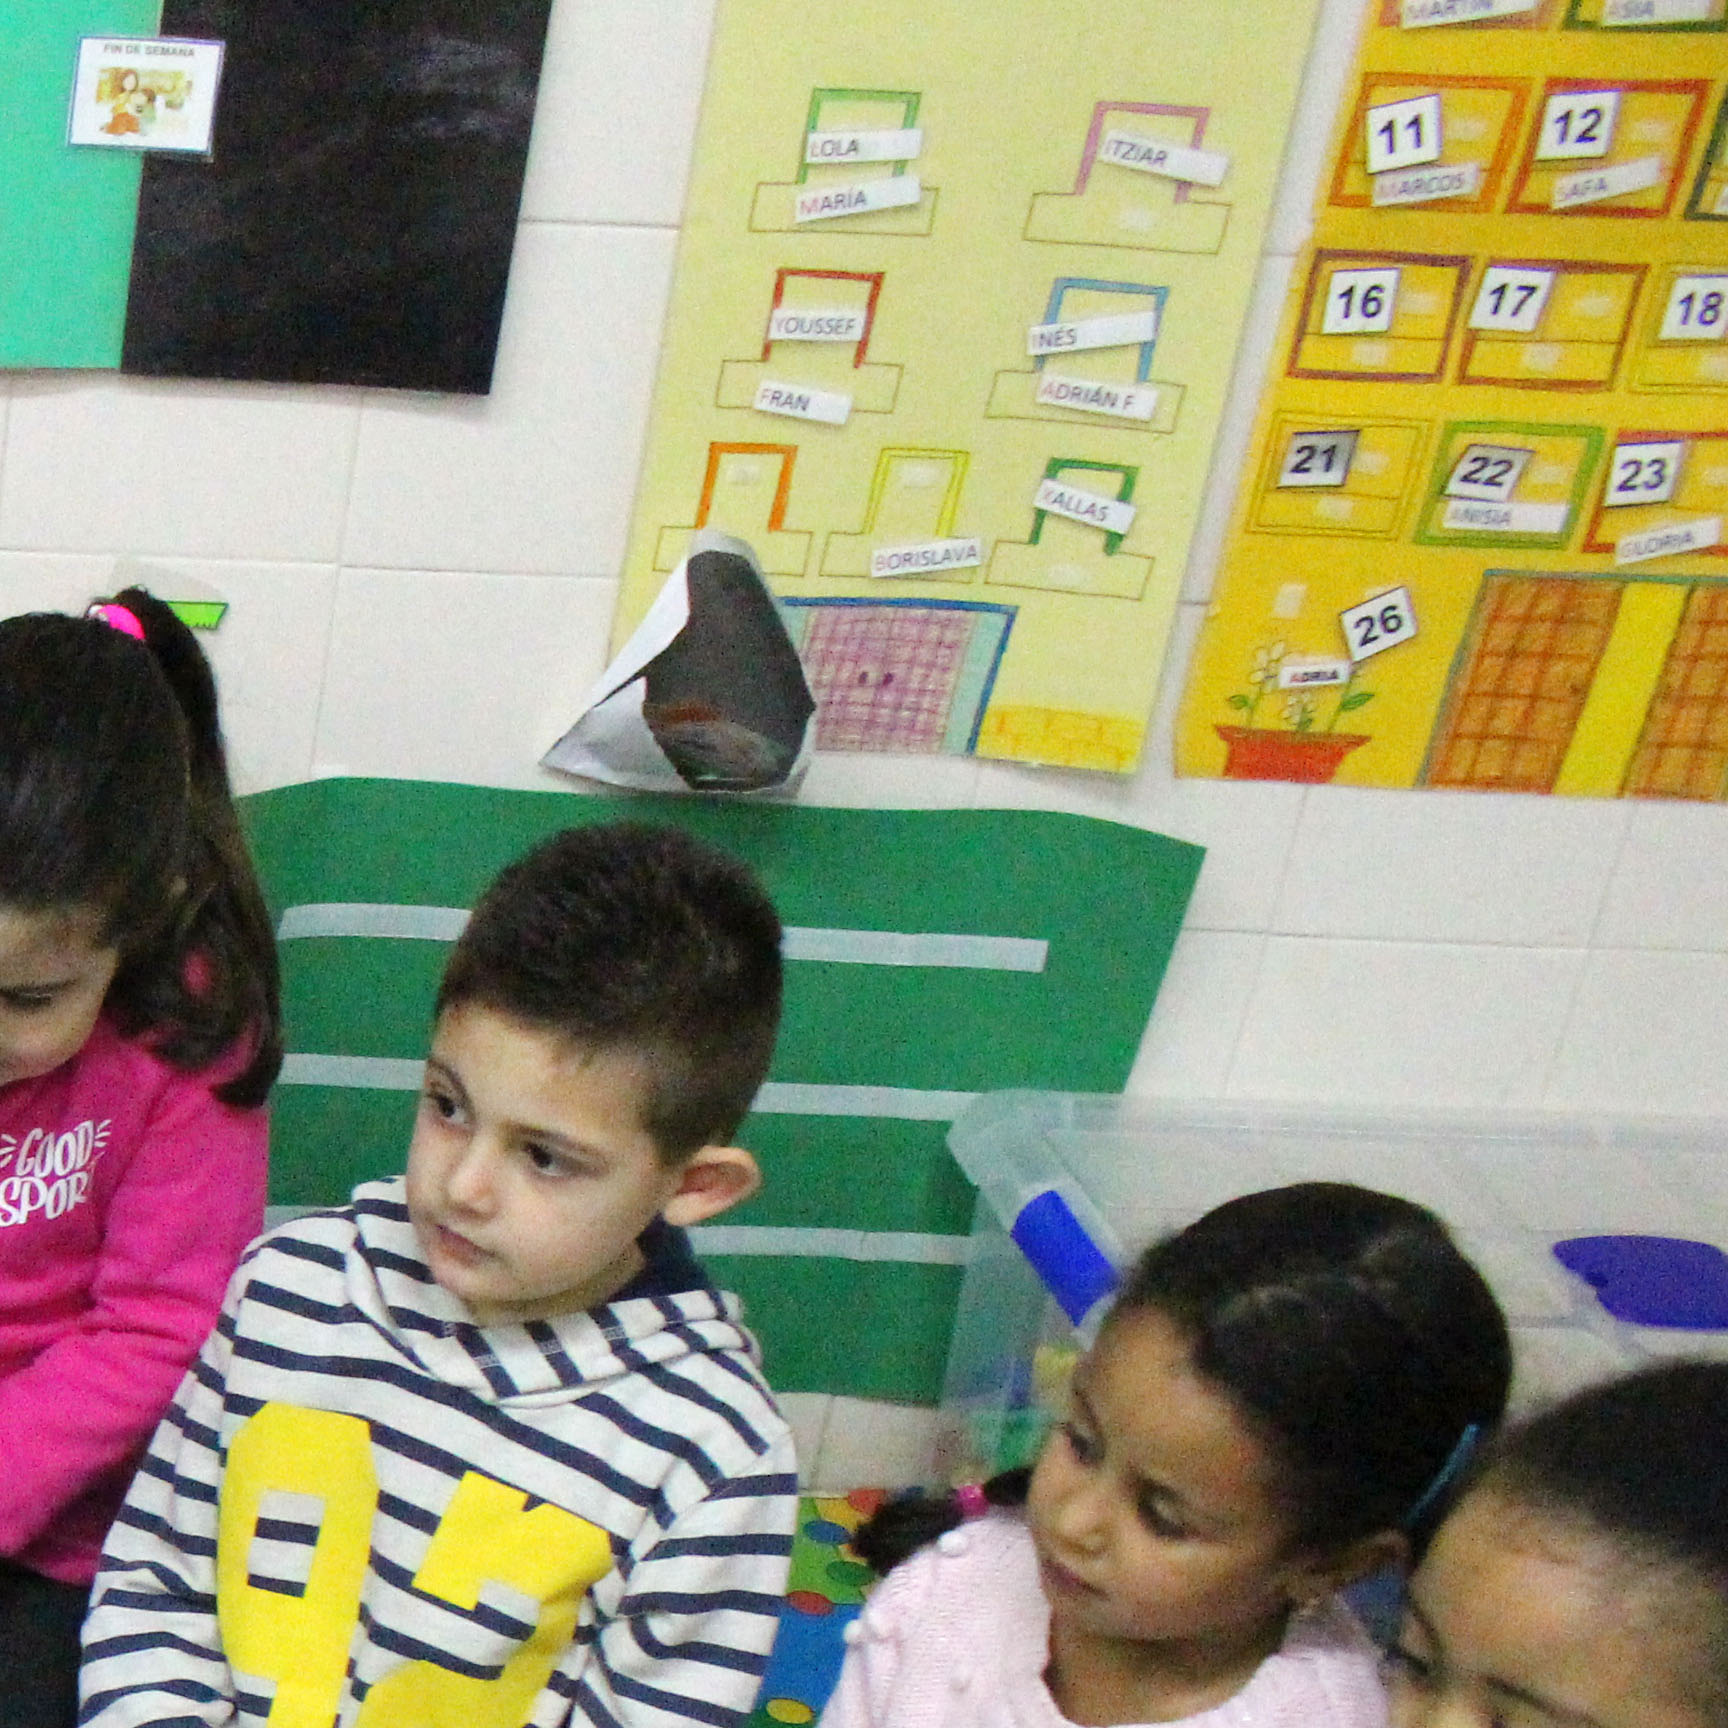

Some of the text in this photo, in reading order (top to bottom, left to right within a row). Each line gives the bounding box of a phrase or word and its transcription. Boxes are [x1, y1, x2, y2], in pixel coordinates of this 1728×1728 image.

[104, 43, 195, 57] FIN DE SEMANA
[1377, 107, 1602, 155] 11 12
[810, 139, 859, 158] LOLA
[1106, 139, 1169, 168] ITZIAR
[1338, 283, 1725, 326] 16 17 18
[774, 316, 857, 335] YOUSSEF
[760, 387, 811, 412] FRAN
[1123, 394, 1135, 410] F
[1290, 443, 1668, 493] 21 22 23
[875, 543, 978, 572] BORISLAVA
[1353, 605, 1403, 648] 26
[16, 1120, 95, 1178] GOOD
